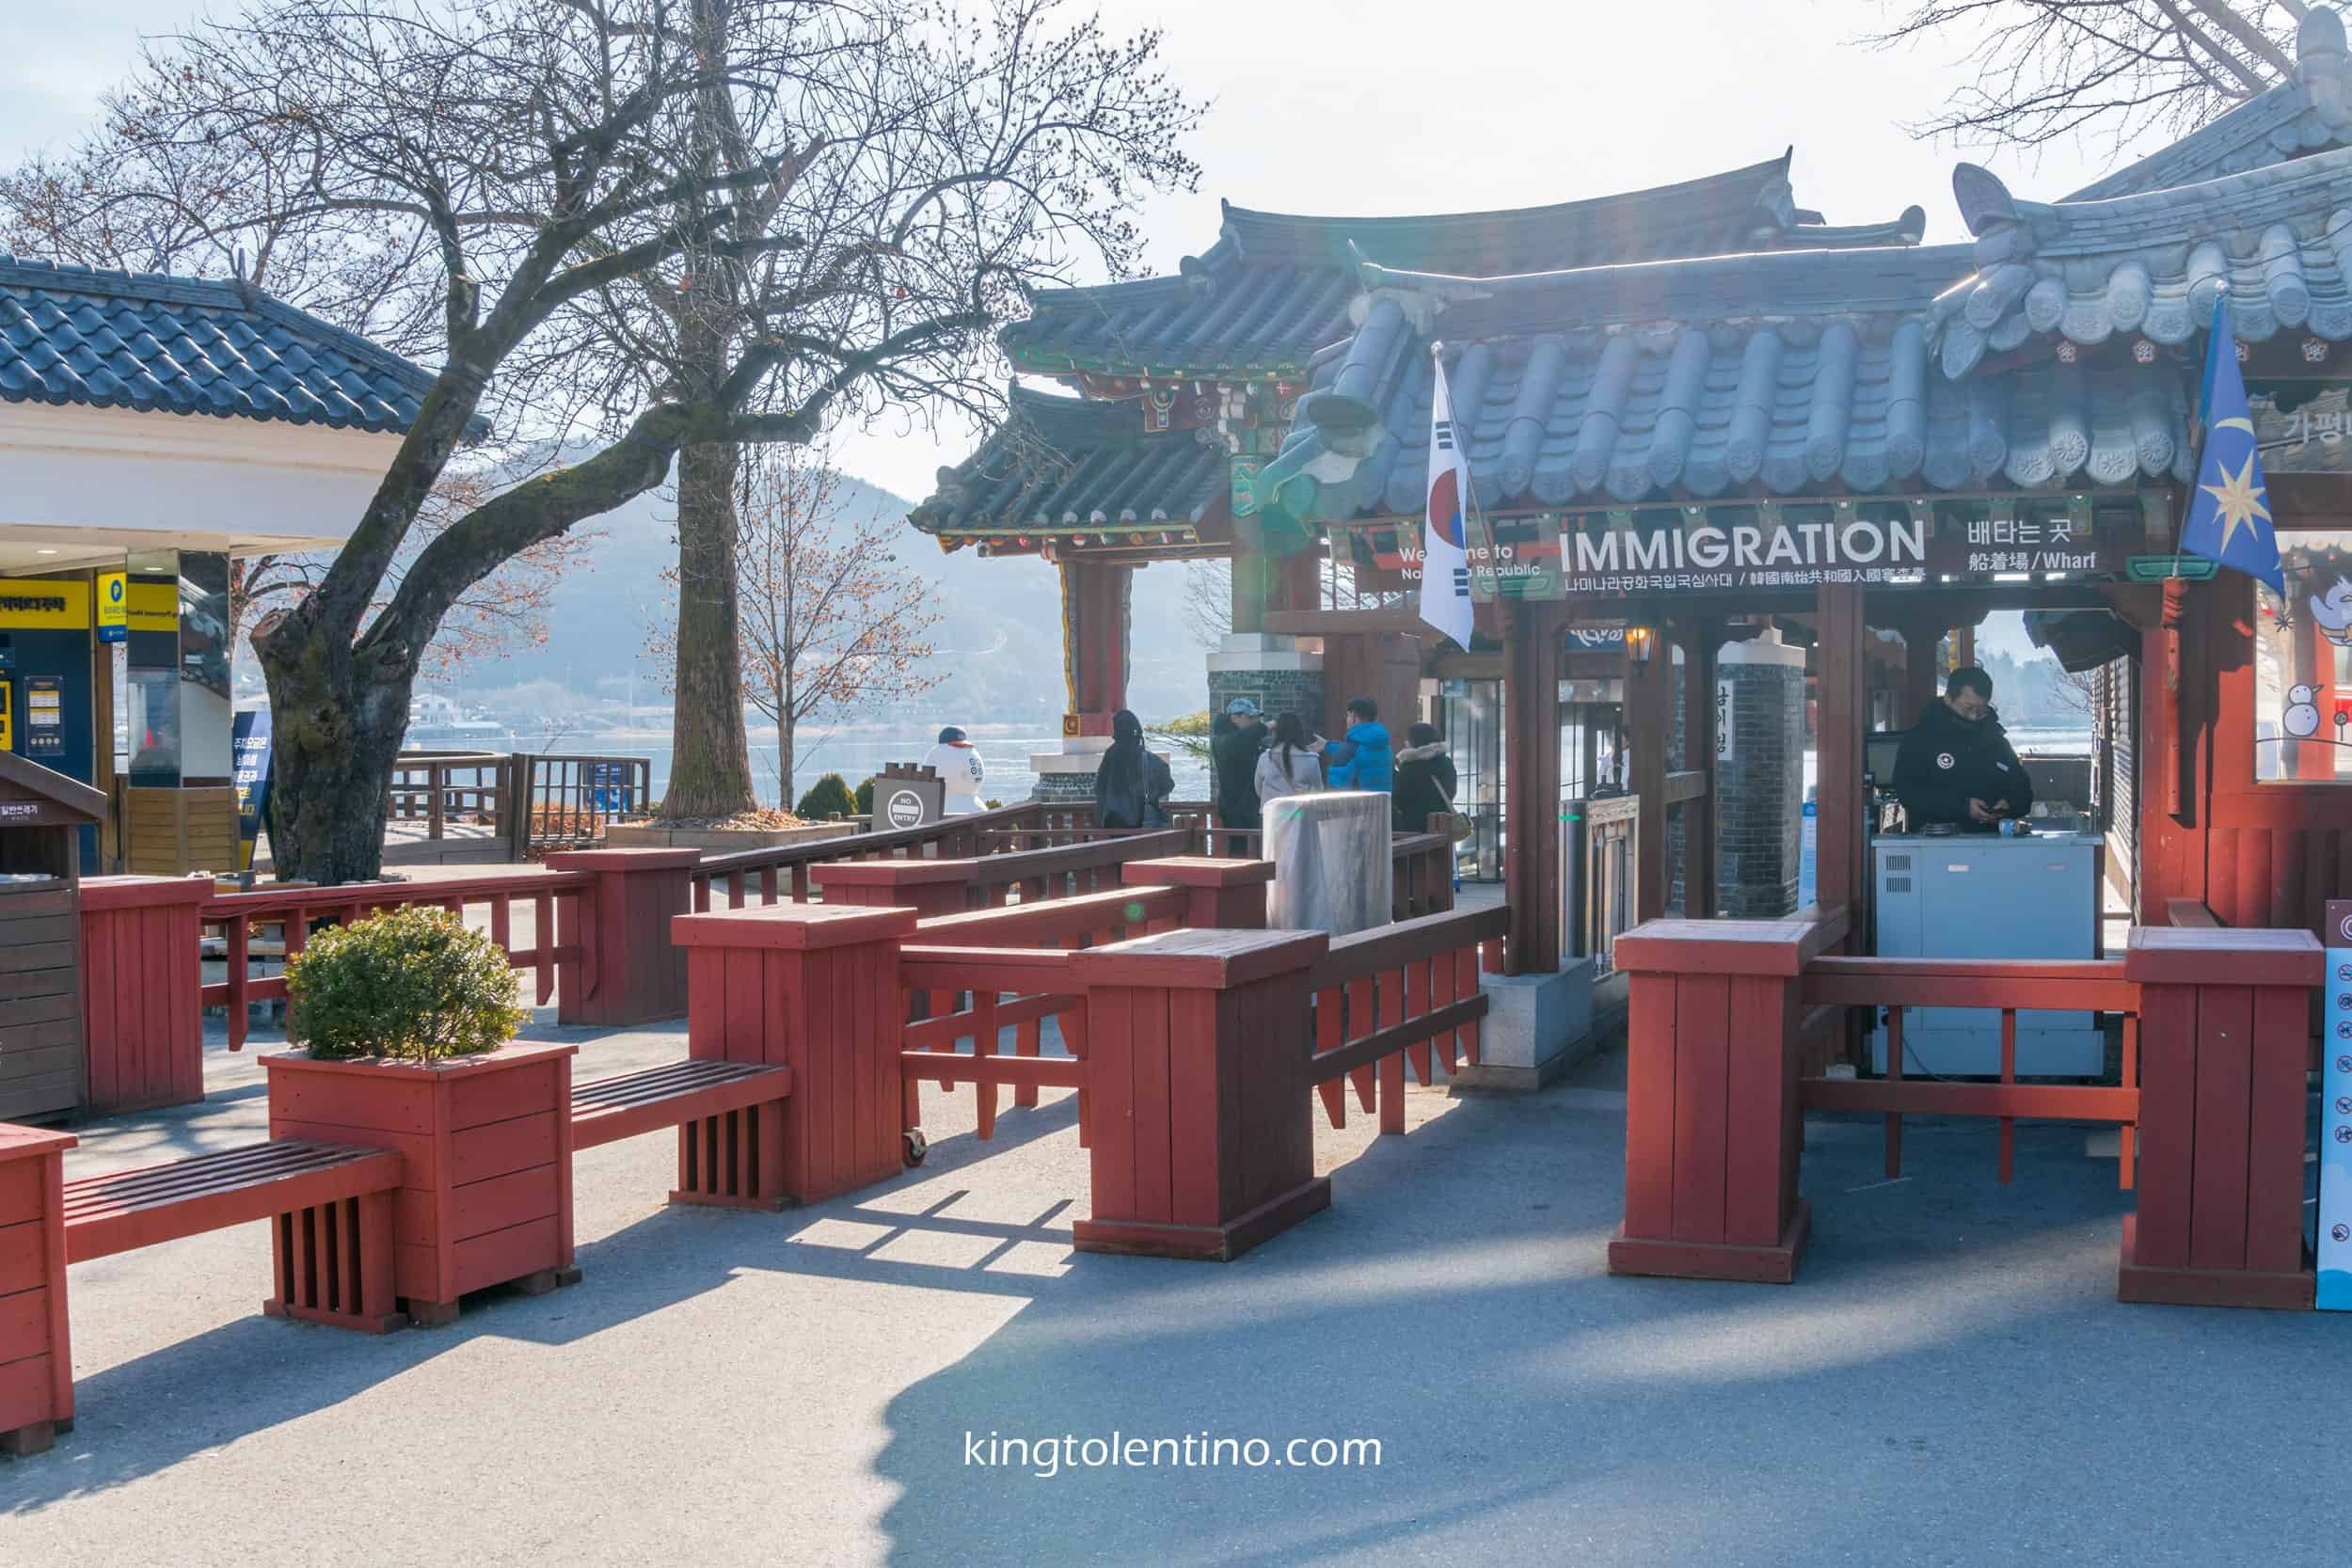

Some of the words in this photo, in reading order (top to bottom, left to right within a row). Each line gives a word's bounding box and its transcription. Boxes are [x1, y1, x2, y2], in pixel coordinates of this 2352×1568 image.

[1968, 519, 2041, 545] 배타는
[2049, 518, 2072, 543] 곳
[1399, 546, 1489, 562] Weme
[1494, 544, 1513, 560] to
[1559, 519, 1926, 573] IMMIGRATION
[1565, 573, 1732, 593] 나미나라공화국입국심사대
